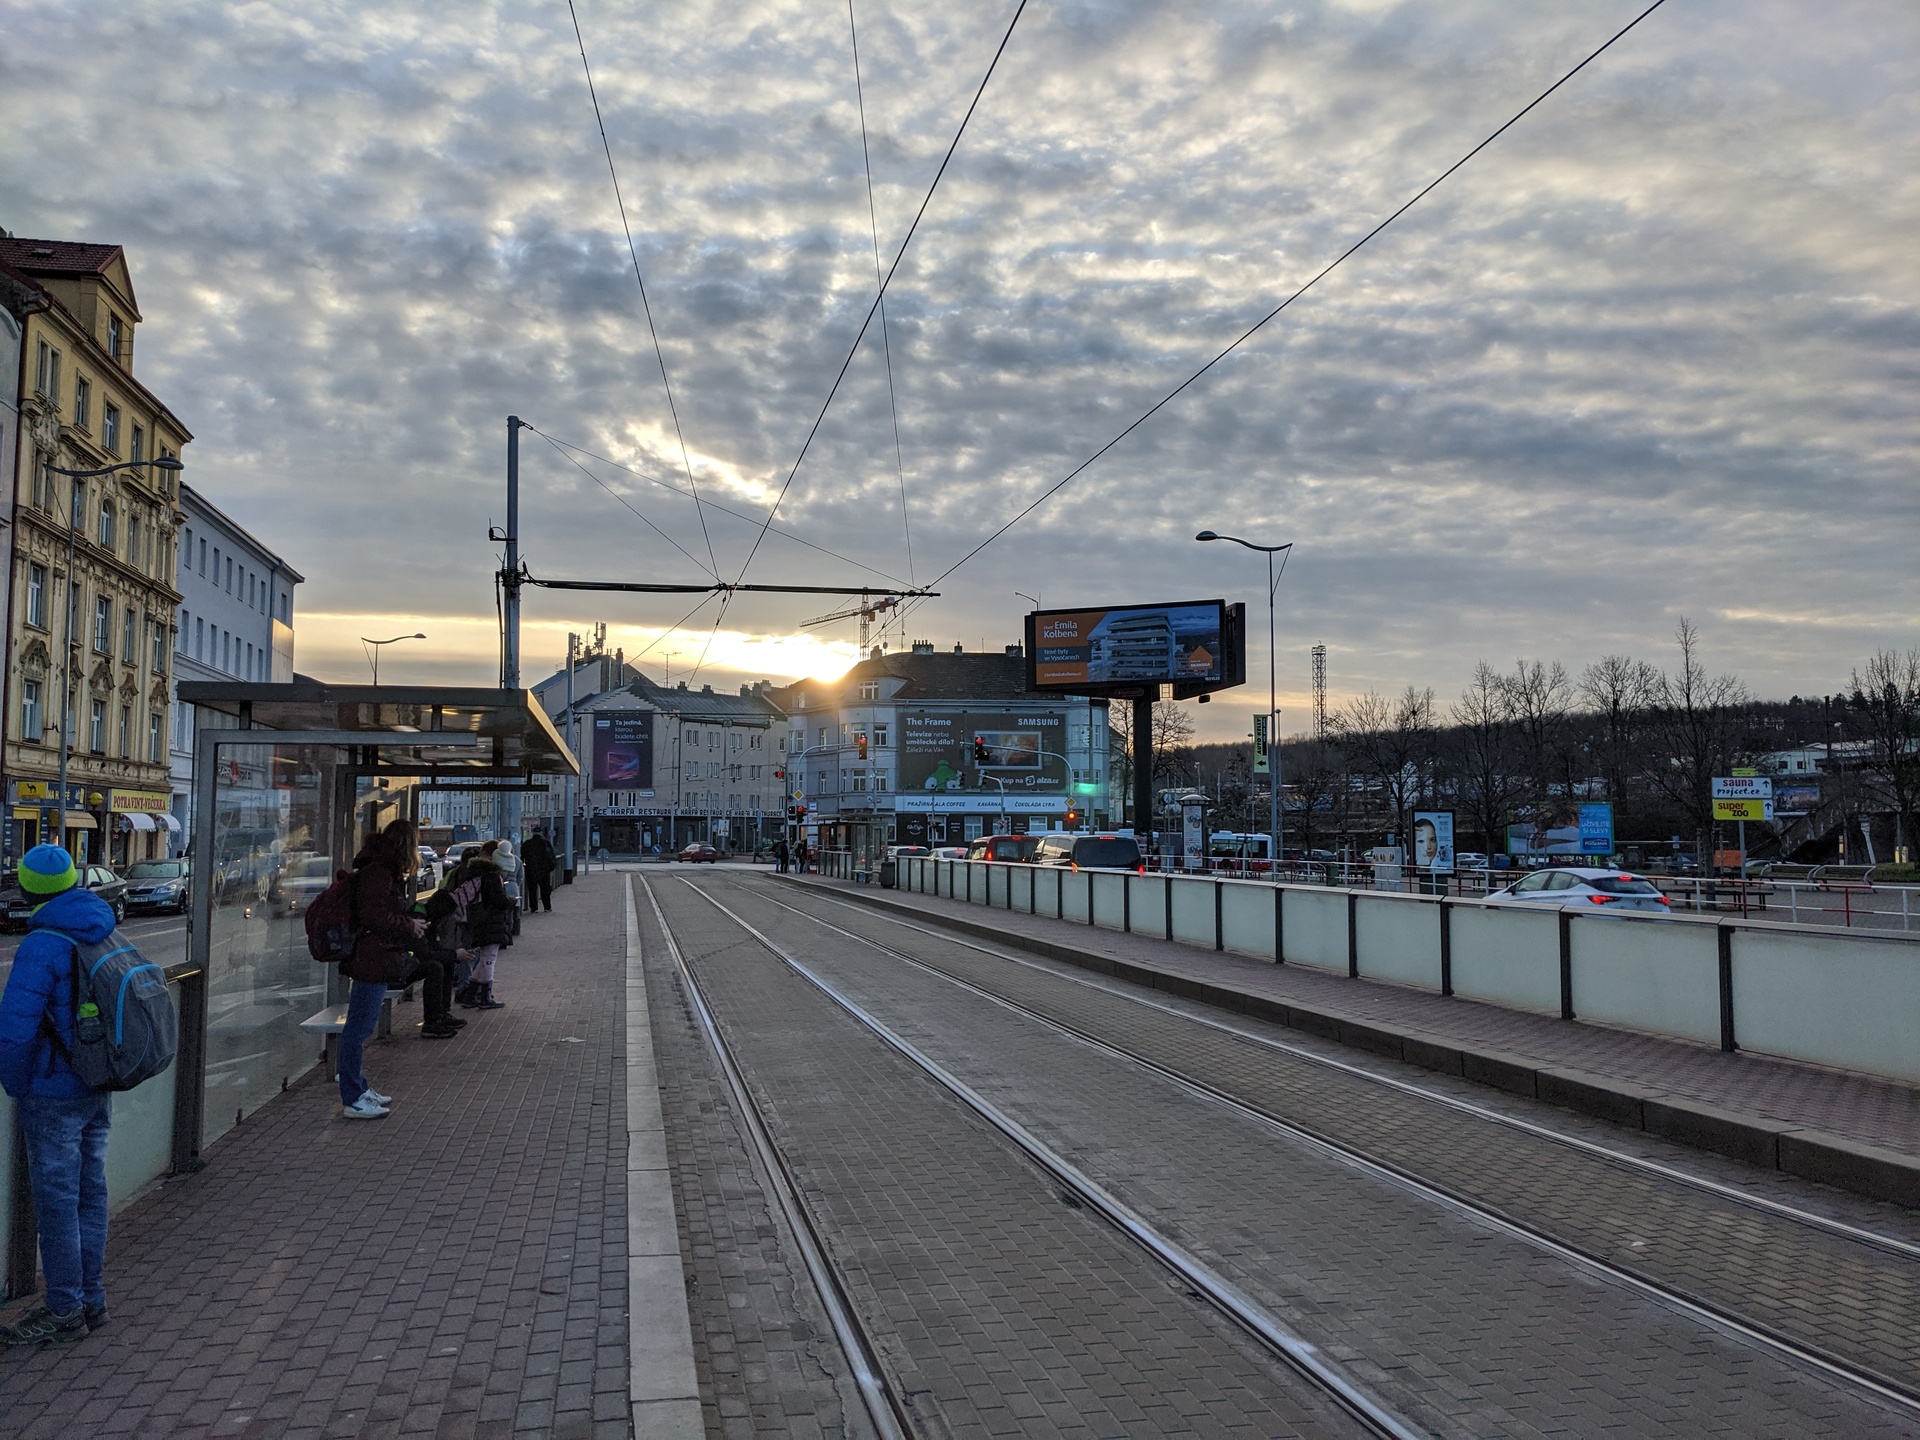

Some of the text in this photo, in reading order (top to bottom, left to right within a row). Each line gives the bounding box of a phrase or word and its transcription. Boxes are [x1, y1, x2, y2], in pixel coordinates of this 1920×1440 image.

[1054, 621, 1077, 629] Emila
[1043, 630, 1078, 638] Kolbena
[906, 717, 952, 726] The Frame
[1018, 718, 1059, 726] SAMSUNG
[1723, 779, 1754, 787] sauna
[1717, 802, 1745, 811] super
